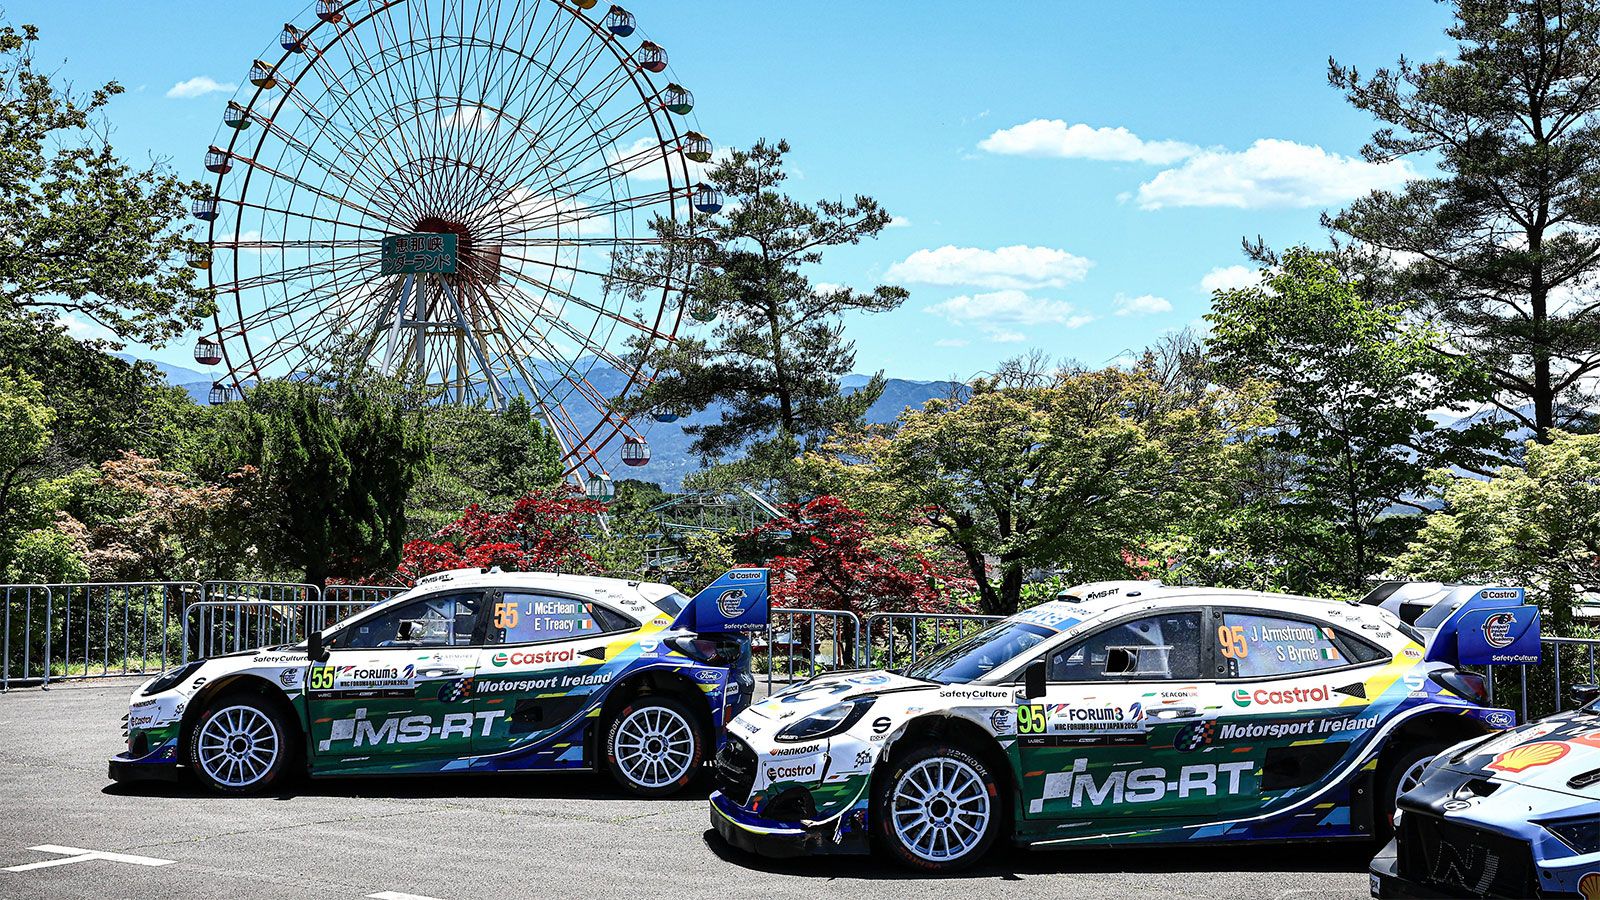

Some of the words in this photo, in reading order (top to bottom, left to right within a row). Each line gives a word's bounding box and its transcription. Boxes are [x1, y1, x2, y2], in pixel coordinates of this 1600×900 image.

[493, 602, 519, 629] 55
[525, 603, 532, 615] J
[535, 601, 575, 615] McErlean
[535, 619, 541, 631] E
[544, 618, 575, 632] Treacy
[724, 623, 764, 631] SafetyCulture
[1251, 626, 1258, 642] J
[1262, 625, 1315, 644] Armstrong
[1217, 625, 1248, 658] 95
[510, 648, 574, 665] Castrol
[1277, 646, 1285, 661] S
[1288, 646, 1319, 664] Byrne
[311, 666, 335, 689] 55
[476, 676, 558, 693] Motorsport
[561, 672, 613, 687] Ireland
[940, 690, 1007, 699] SafetyCulture
[1254, 685, 1329, 705] Castrol
[1017, 705, 1046, 733] 95
[1219, 718, 1314, 740] Motorsport
[1318, 714, 1380, 733] Ireland
[1490, 713, 1508, 723] Ford
[353, 709, 506, 748] MS-RT
[777, 764, 816, 778] Castrol
[1071, 761, 1255, 808] MS-RT
